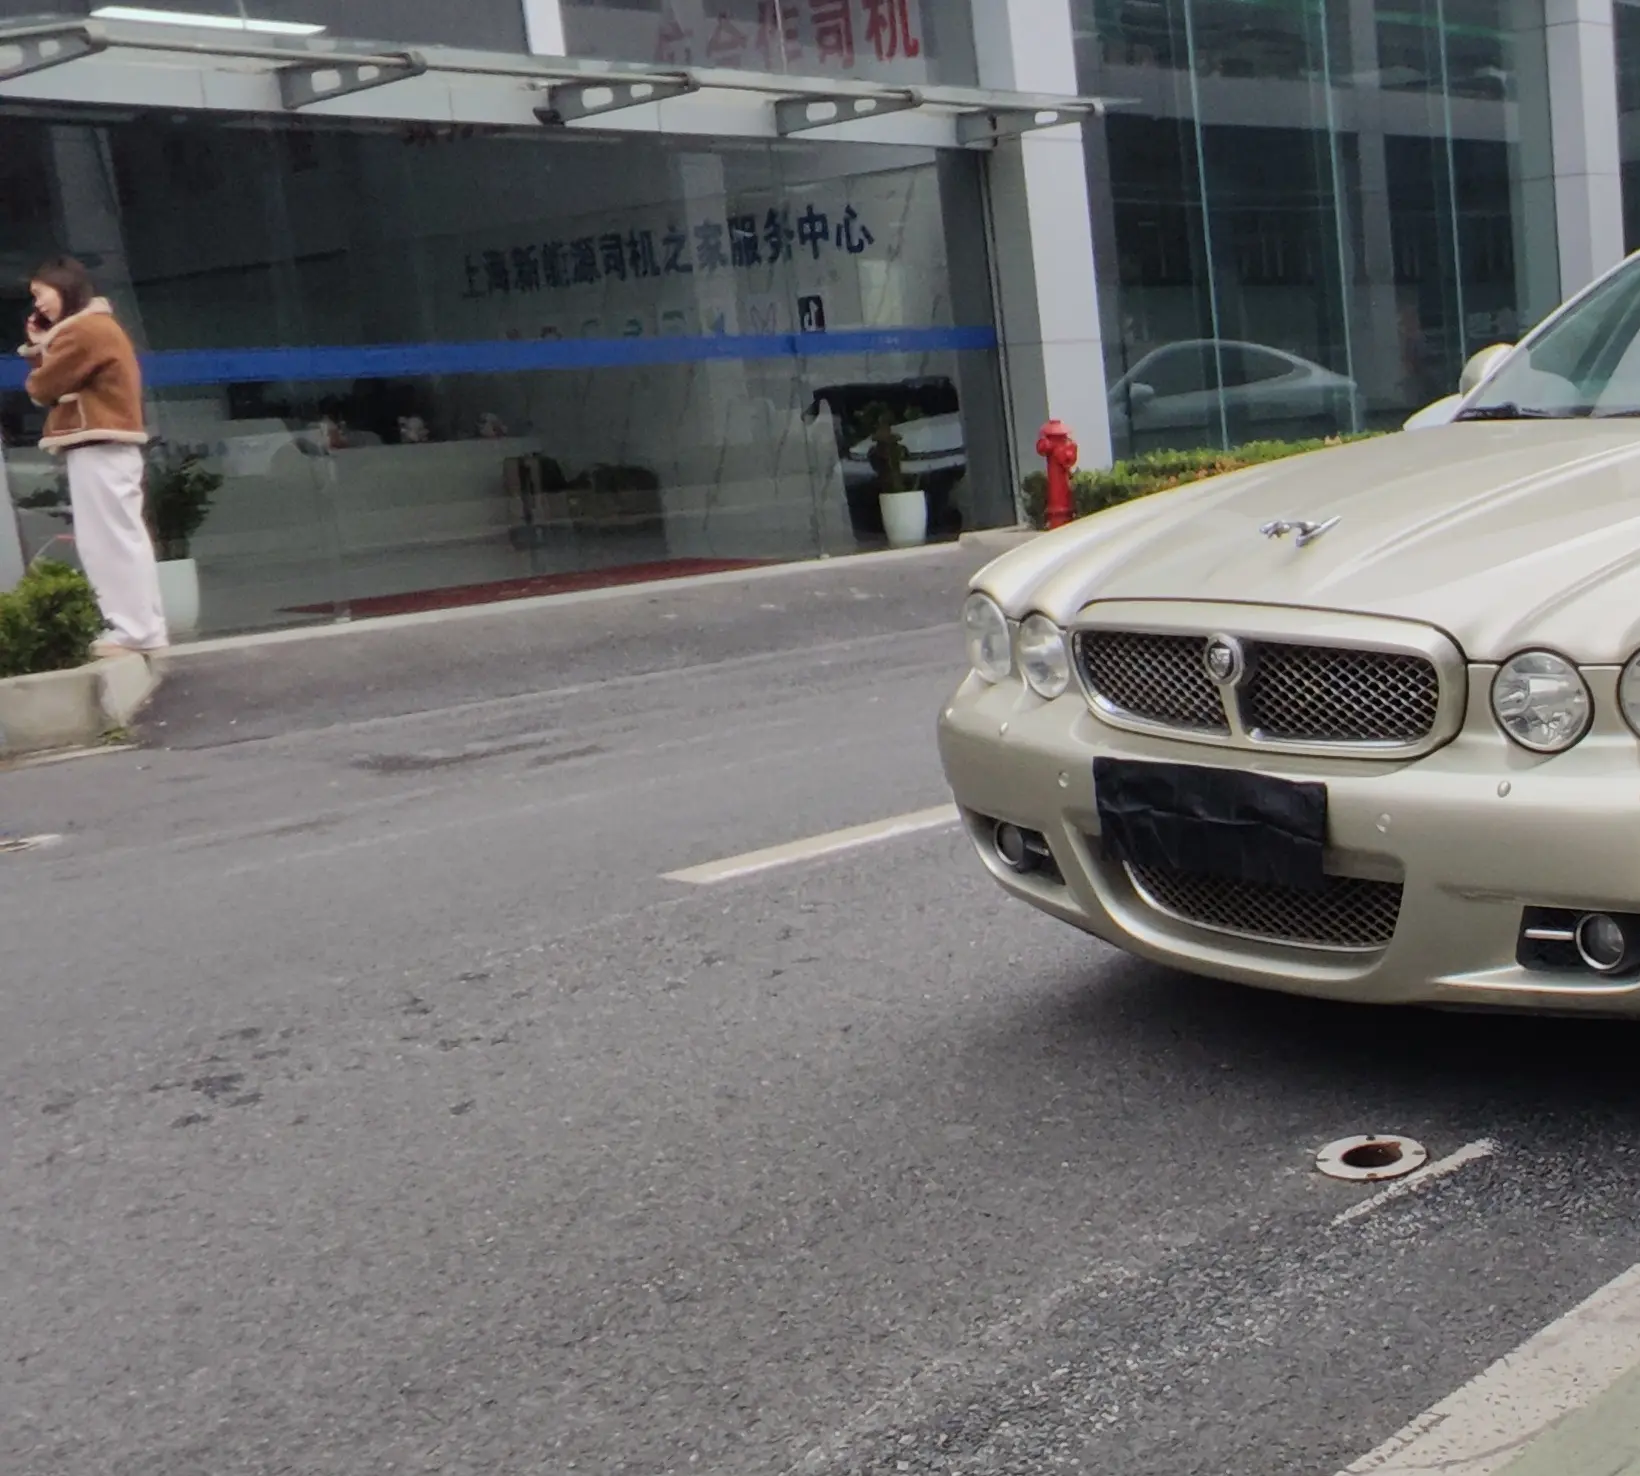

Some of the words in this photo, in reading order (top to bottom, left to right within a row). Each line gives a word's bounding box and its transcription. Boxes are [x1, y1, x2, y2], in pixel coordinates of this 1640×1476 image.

[463, 204, 875, 299] 上海新能源司机之家服务中心
